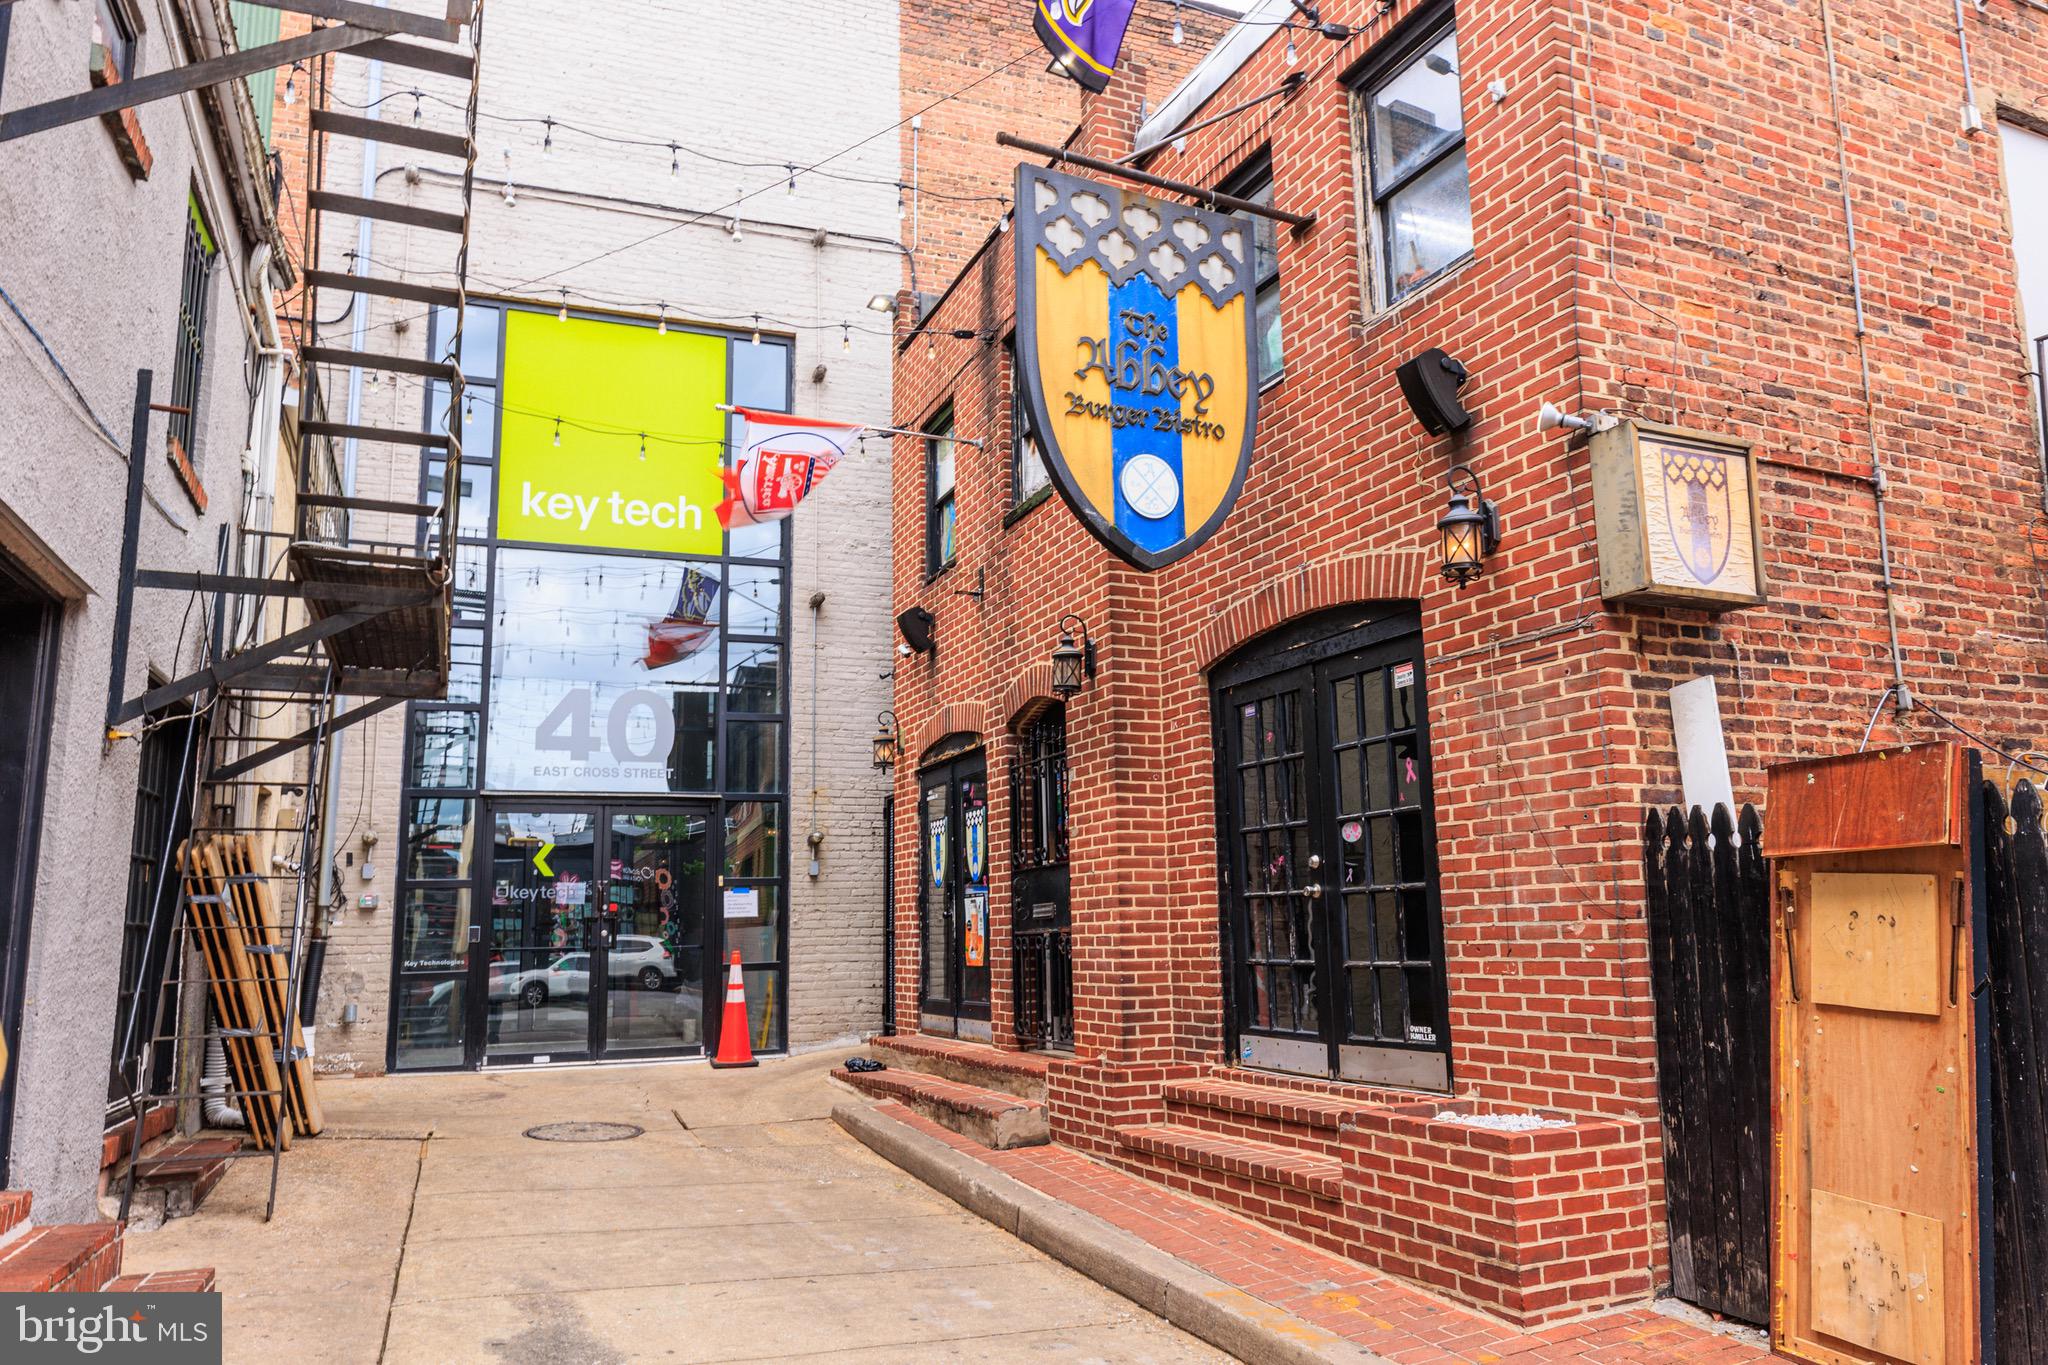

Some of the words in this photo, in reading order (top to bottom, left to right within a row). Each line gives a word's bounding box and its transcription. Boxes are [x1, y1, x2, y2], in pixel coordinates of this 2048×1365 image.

[1119, 310, 1168, 342] The
[1073, 336, 1215, 414] Abbey
[1064, 391, 1149, 429] Burger
[1152, 405, 1225, 441] Bistro
[521, 481, 600, 531] key
[607, 491, 702, 530] tech
[535, 688, 675, 763] 40
[532, 765, 570, 777] EAST
[573, 767, 620, 779] CROSS
[1410, 1025, 1432, 1034] OWNER
